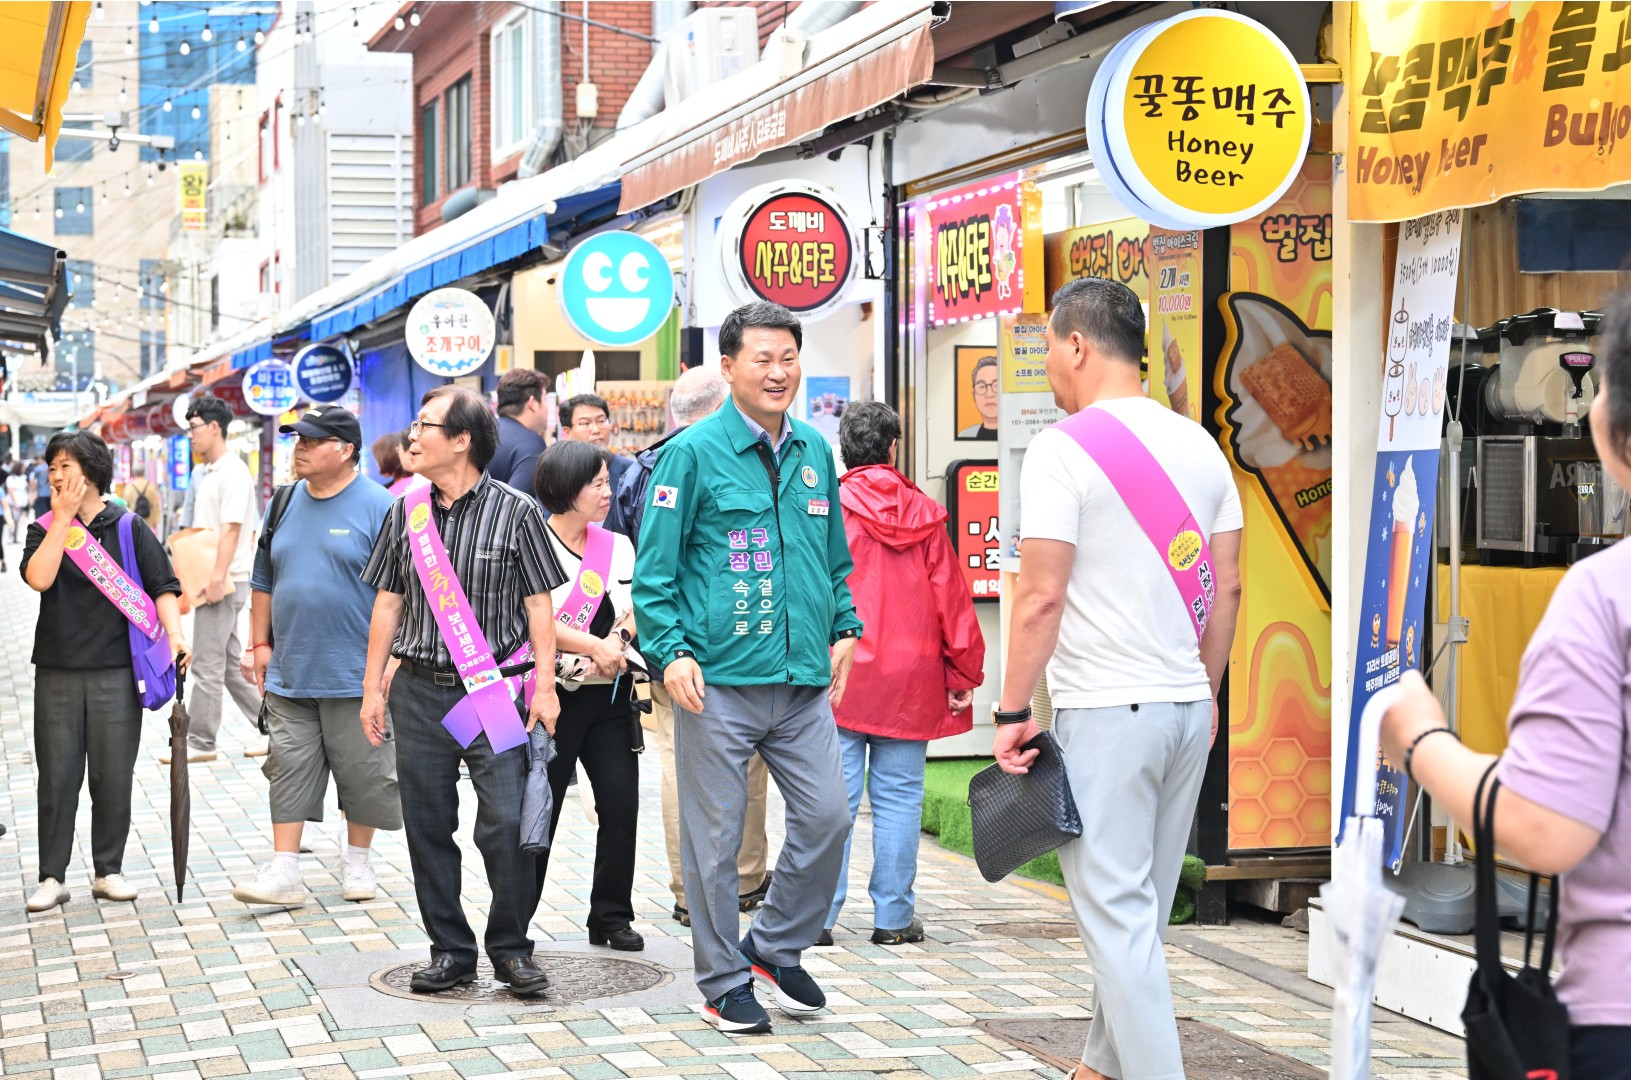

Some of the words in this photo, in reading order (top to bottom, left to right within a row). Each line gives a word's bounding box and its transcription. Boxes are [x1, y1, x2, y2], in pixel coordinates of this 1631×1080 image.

[1168, 130, 1254, 164] Honey
[1176, 159, 1244, 187] Beer
[1357, 145, 1431, 196] Honey
[769, 210, 825, 233] 도깨비
[1167, 230, 1199, 250] 아이스크림
[1261, 213, 1332, 262] 벌집
[754, 240, 836, 288] 사주&타로
[937, 216, 992, 304] 사주&타로
[1117, 235, 1149, 283] 아
[1160, 267, 1177, 288] 2개
[1158, 294, 1192, 313] 10,000원
[426, 335, 480, 353] 조개구이
[1029, 347, 1049, 355] 아이스
[1568, 355, 1587, 363] PULL
[1034, 369, 1047, 377] 아이
[448, 611, 478, 659] 보내세요
[466, 652, 491, 667] 해운대구
